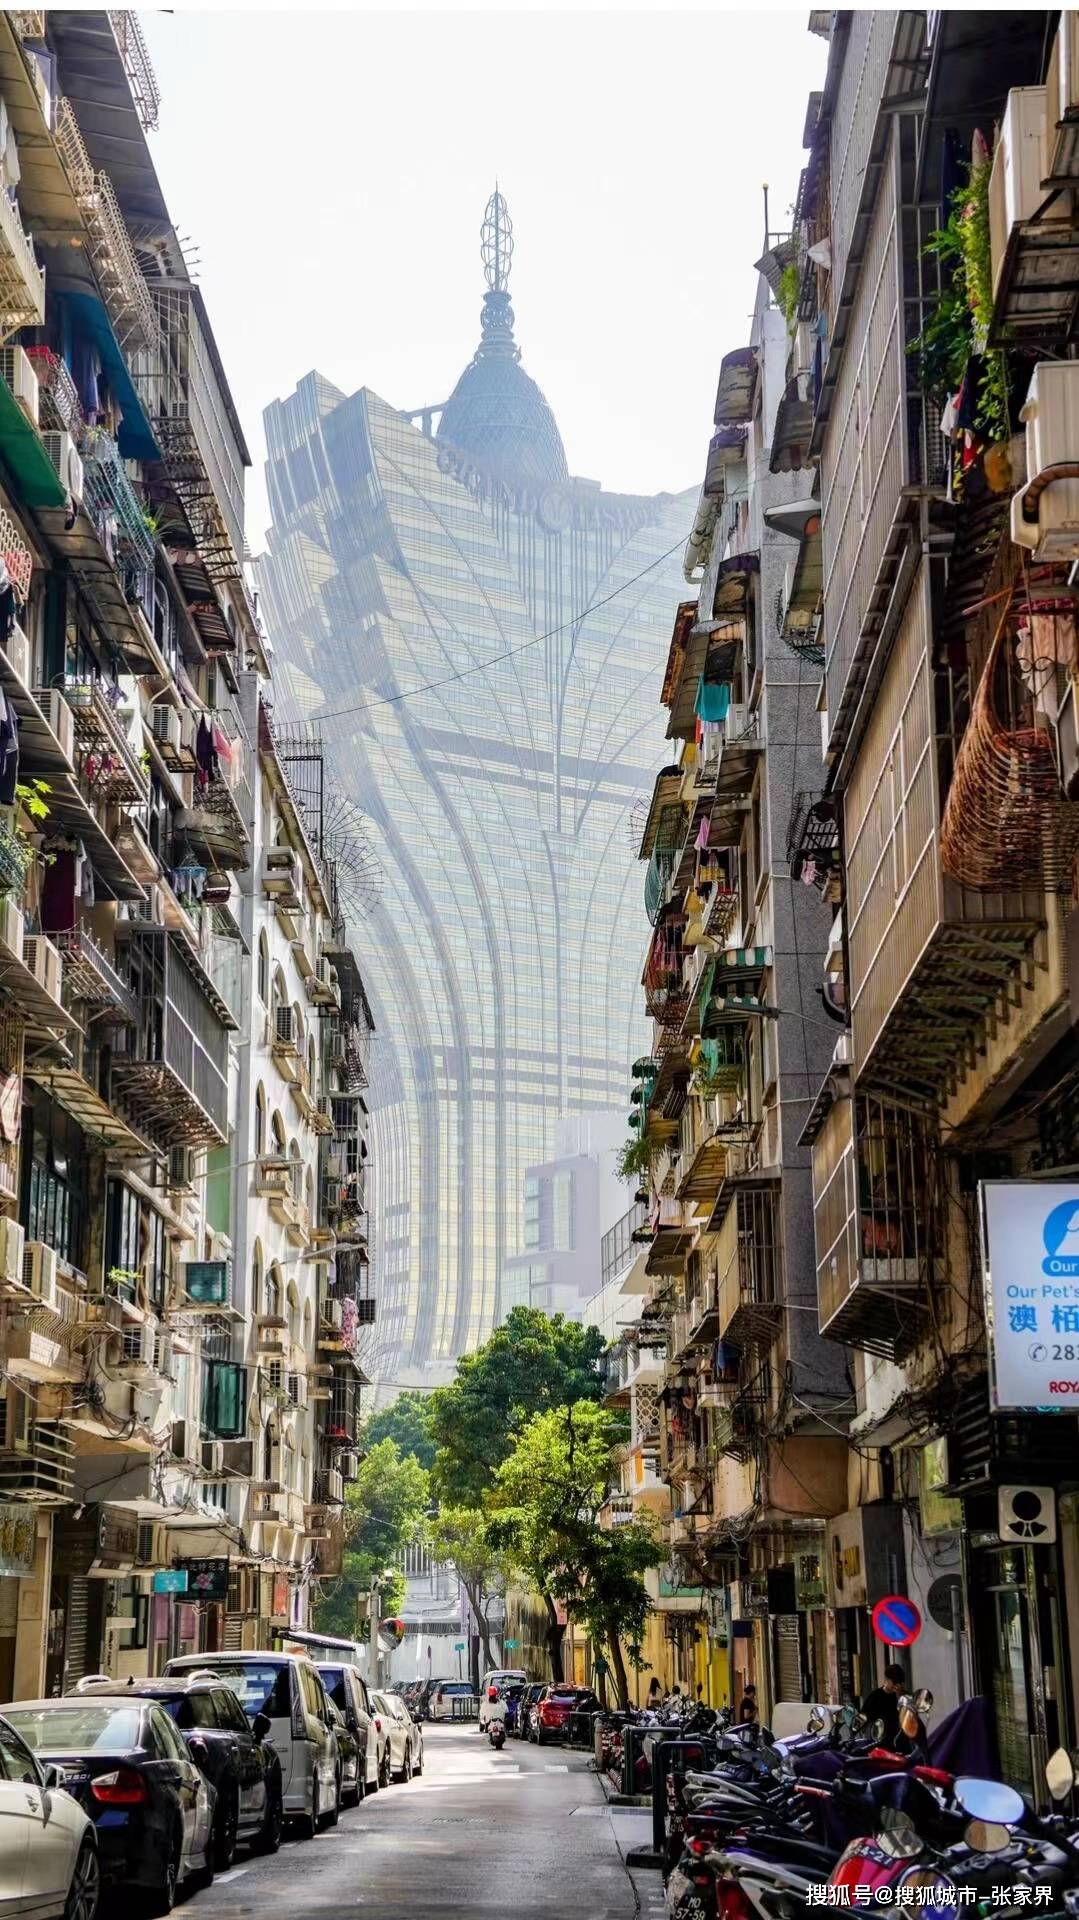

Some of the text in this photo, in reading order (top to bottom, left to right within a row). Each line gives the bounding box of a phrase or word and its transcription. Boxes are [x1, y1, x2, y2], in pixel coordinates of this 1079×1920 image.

[1050, 1261, 1077, 1273] Our
[1006, 1284, 1079, 1298] Our Pet's
[1052, 1344, 1079, 1361] 28
[1049, 1381, 1079, 1394] ROY
